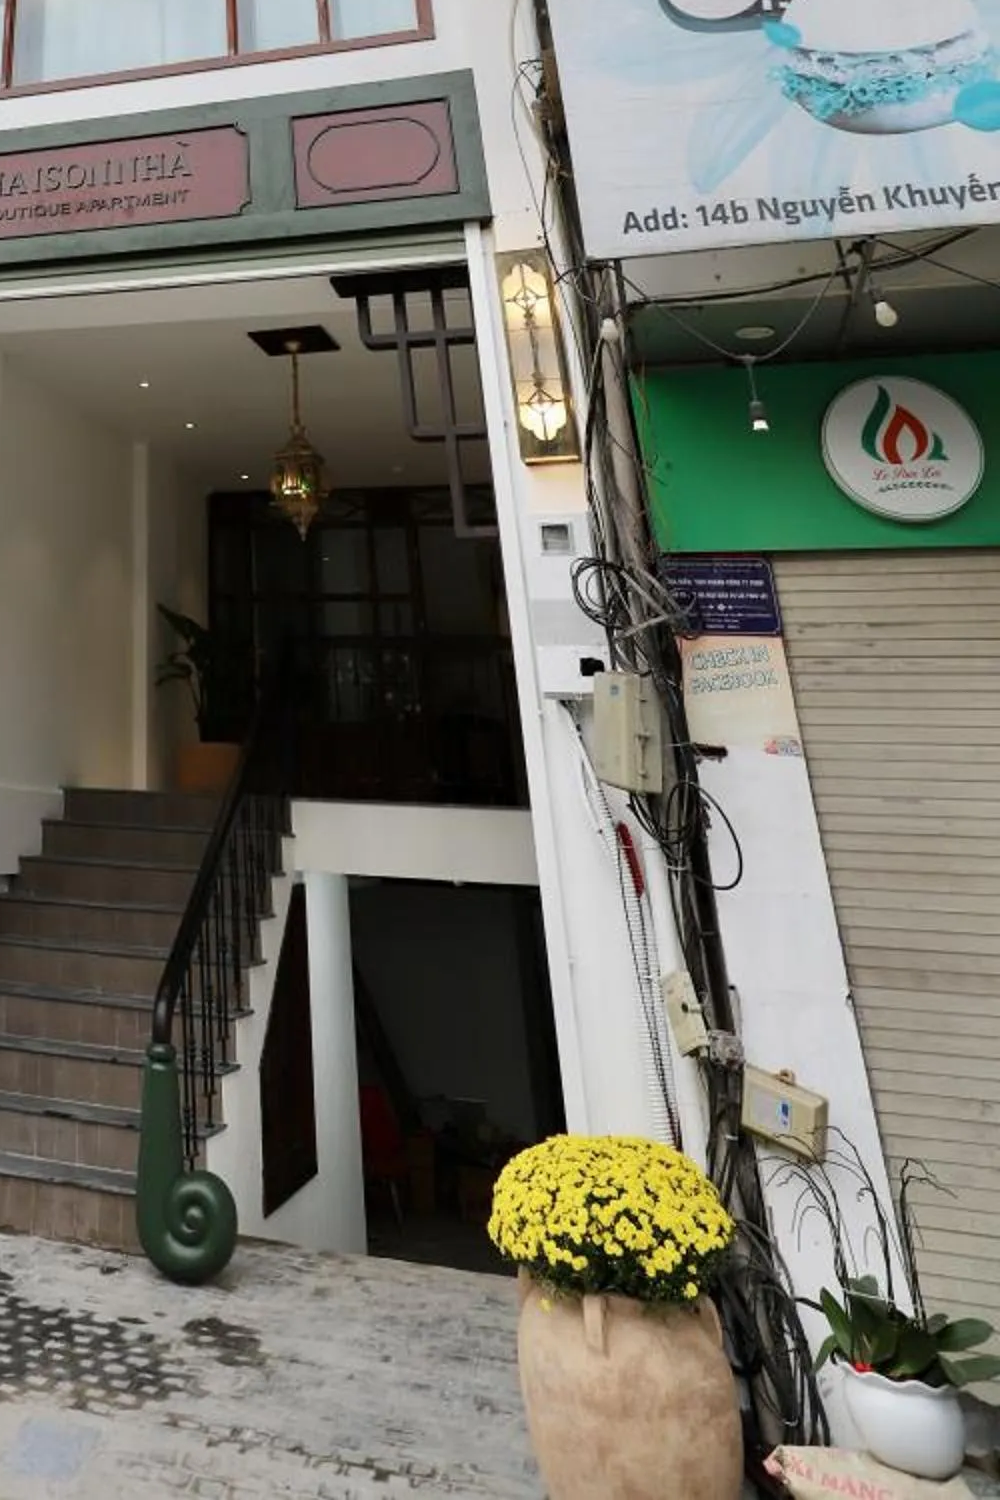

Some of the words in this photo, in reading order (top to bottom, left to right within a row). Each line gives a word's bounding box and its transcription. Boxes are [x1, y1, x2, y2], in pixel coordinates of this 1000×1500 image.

[76, 189, 191, 214] APARTMENT
[623, 205, 688, 235] Add:
[695, 201, 748, 227] 14b
[757, 186, 876, 226] Nguyễn
